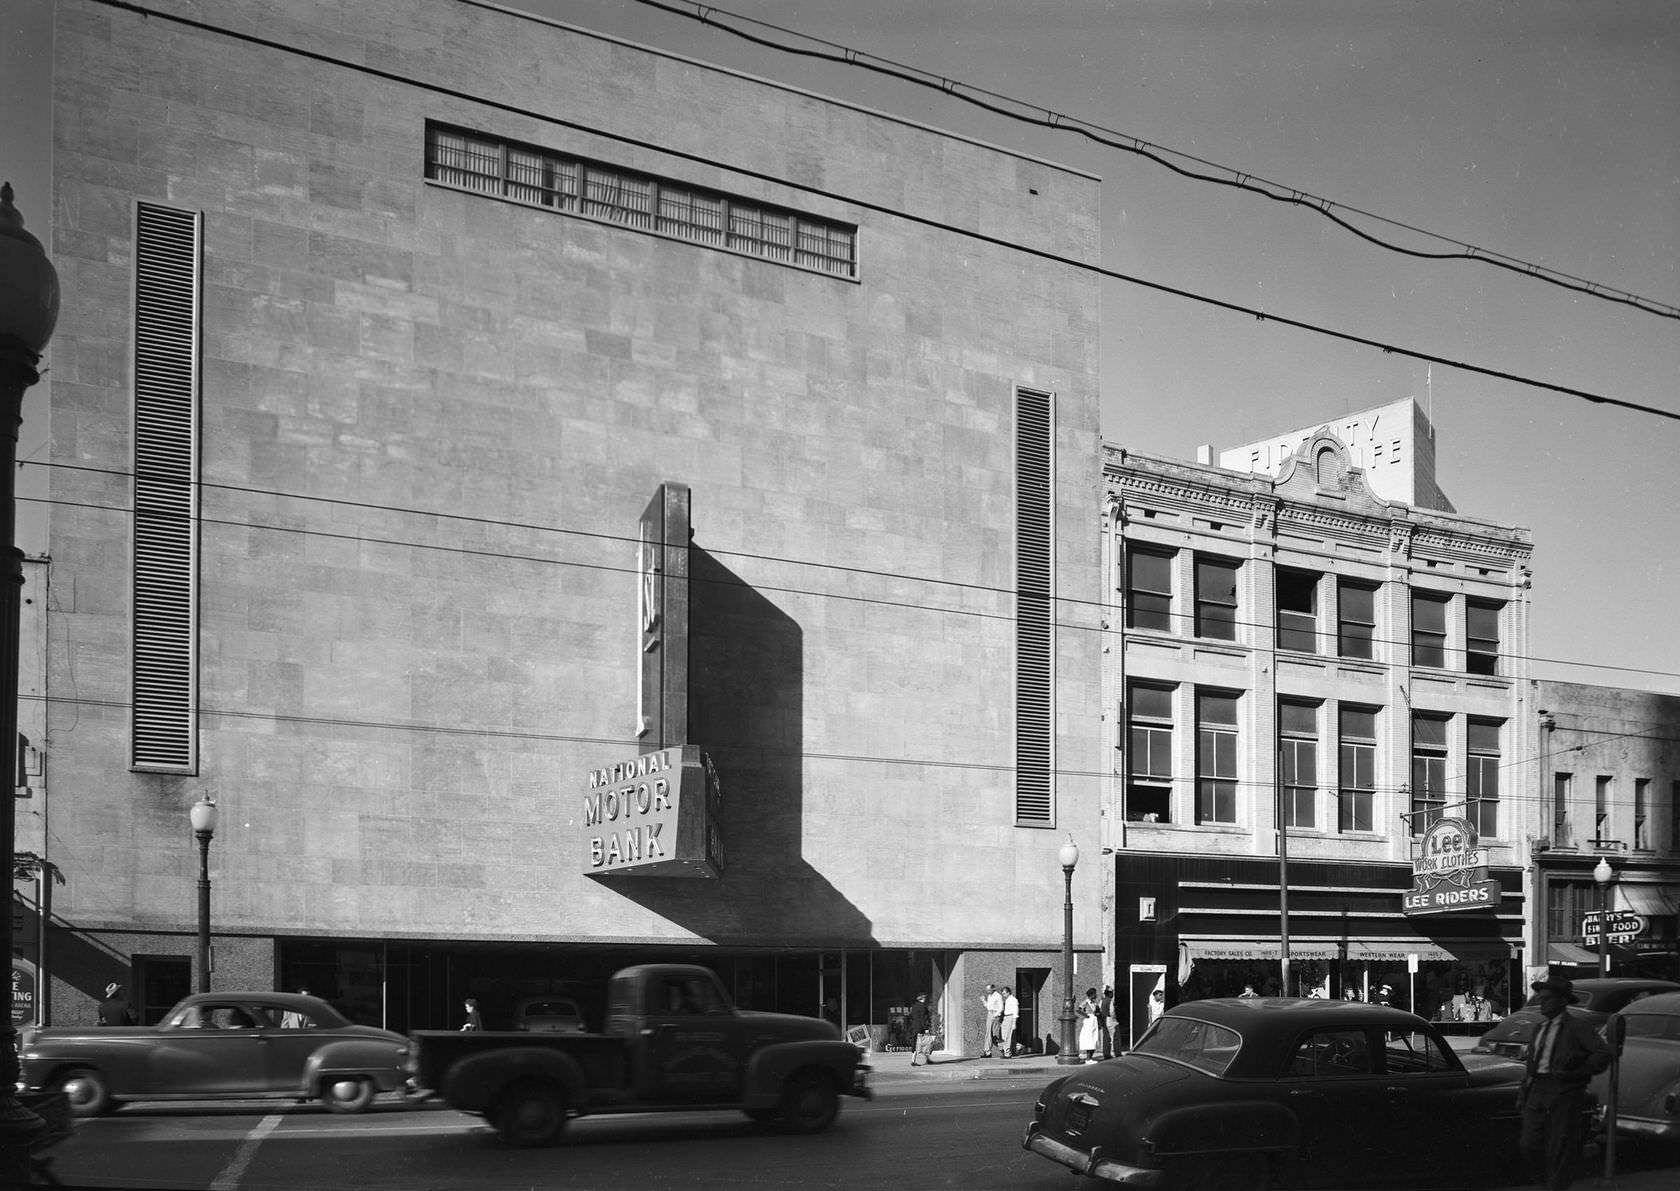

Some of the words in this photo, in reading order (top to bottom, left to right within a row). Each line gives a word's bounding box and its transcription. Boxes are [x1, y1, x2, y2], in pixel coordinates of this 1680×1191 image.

[590, 751, 672, 789] NATIONAL
[584, 777, 672, 827] MOTOR
[591, 823, 665, 867] BANK
[1431, 834, 1463, 854] Lee
[1415, 856, 1438, 871] WORK
[1441, 851, 1479, 869] CLOTHES
[1405, 894, 1430, 908] LEE
[1435, 888, 1489, 905] RIDERS
[1613, 921, 1639, 931] FOOD
